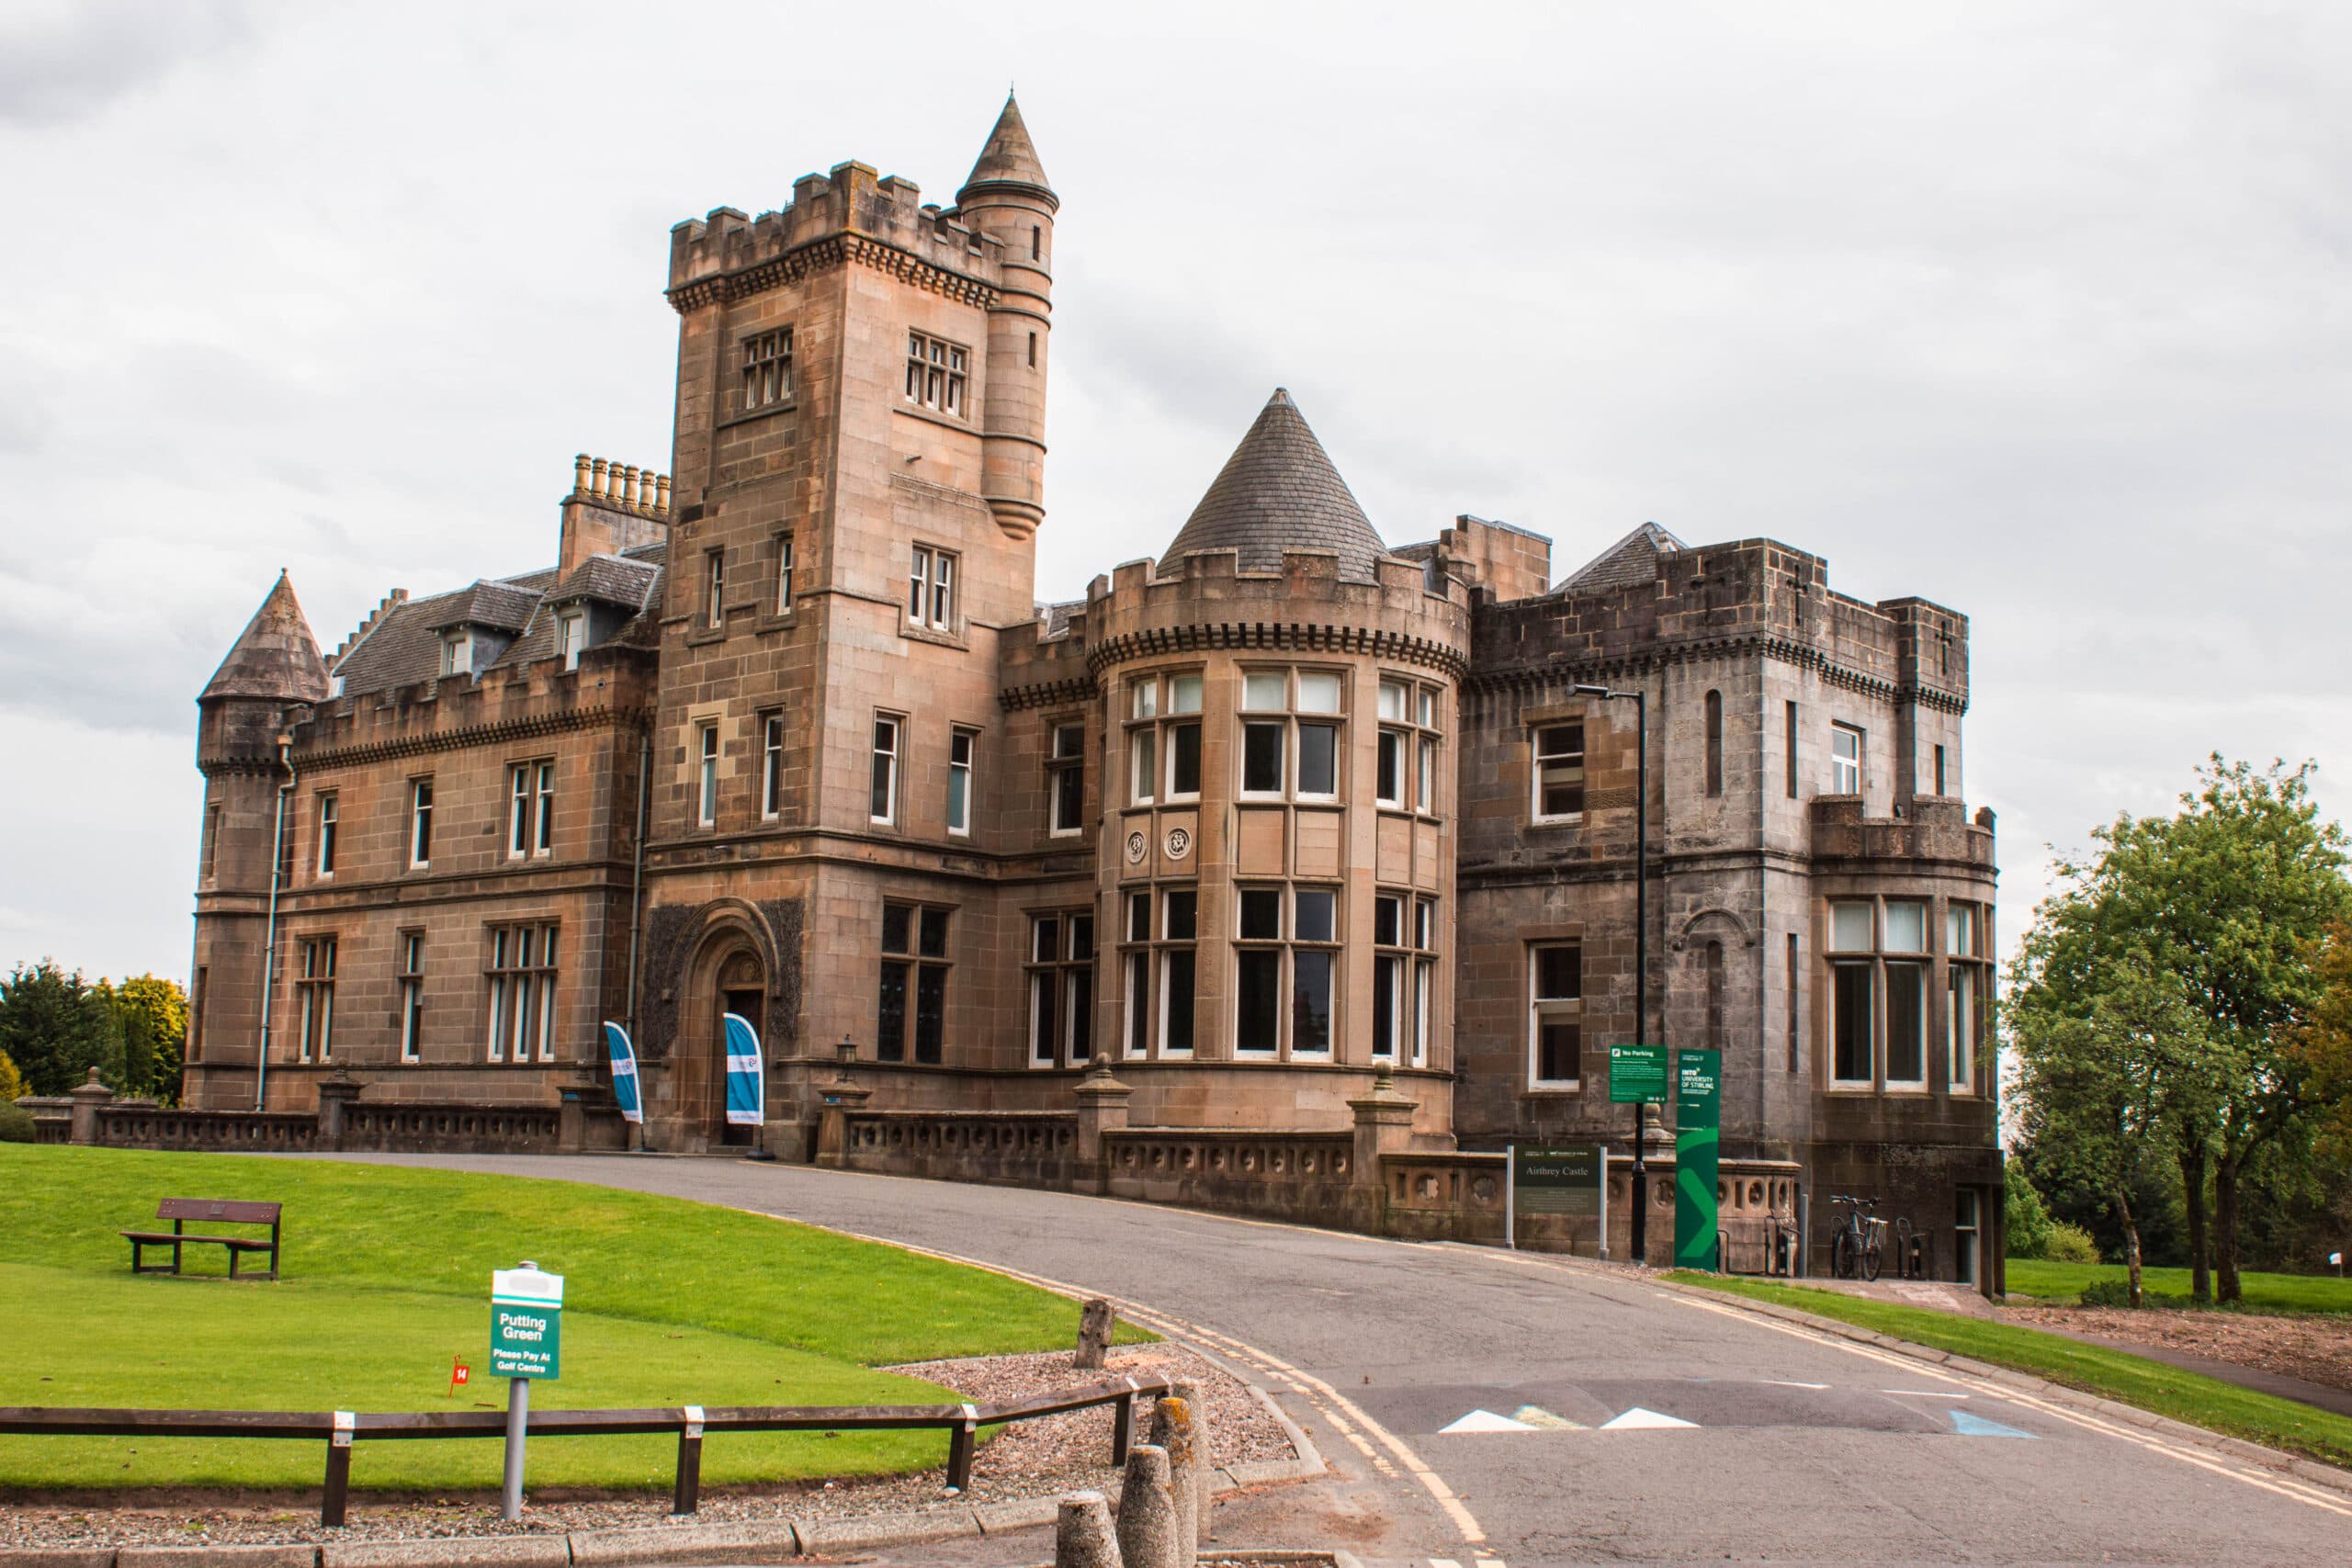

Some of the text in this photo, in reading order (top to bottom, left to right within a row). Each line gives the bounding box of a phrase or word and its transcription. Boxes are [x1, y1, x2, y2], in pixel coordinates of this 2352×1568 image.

[1526, 1166, 1589, 1178] Airthrey Castle
[500, 1313, 547, 1332] Putting
[503, 1325, 543, 1342] Green
[492, 1348, 551, 1363] Please Pay At
[497, 1360, 547, 1373] Golf Centre
[457, 1369, 467, 1381] 14
